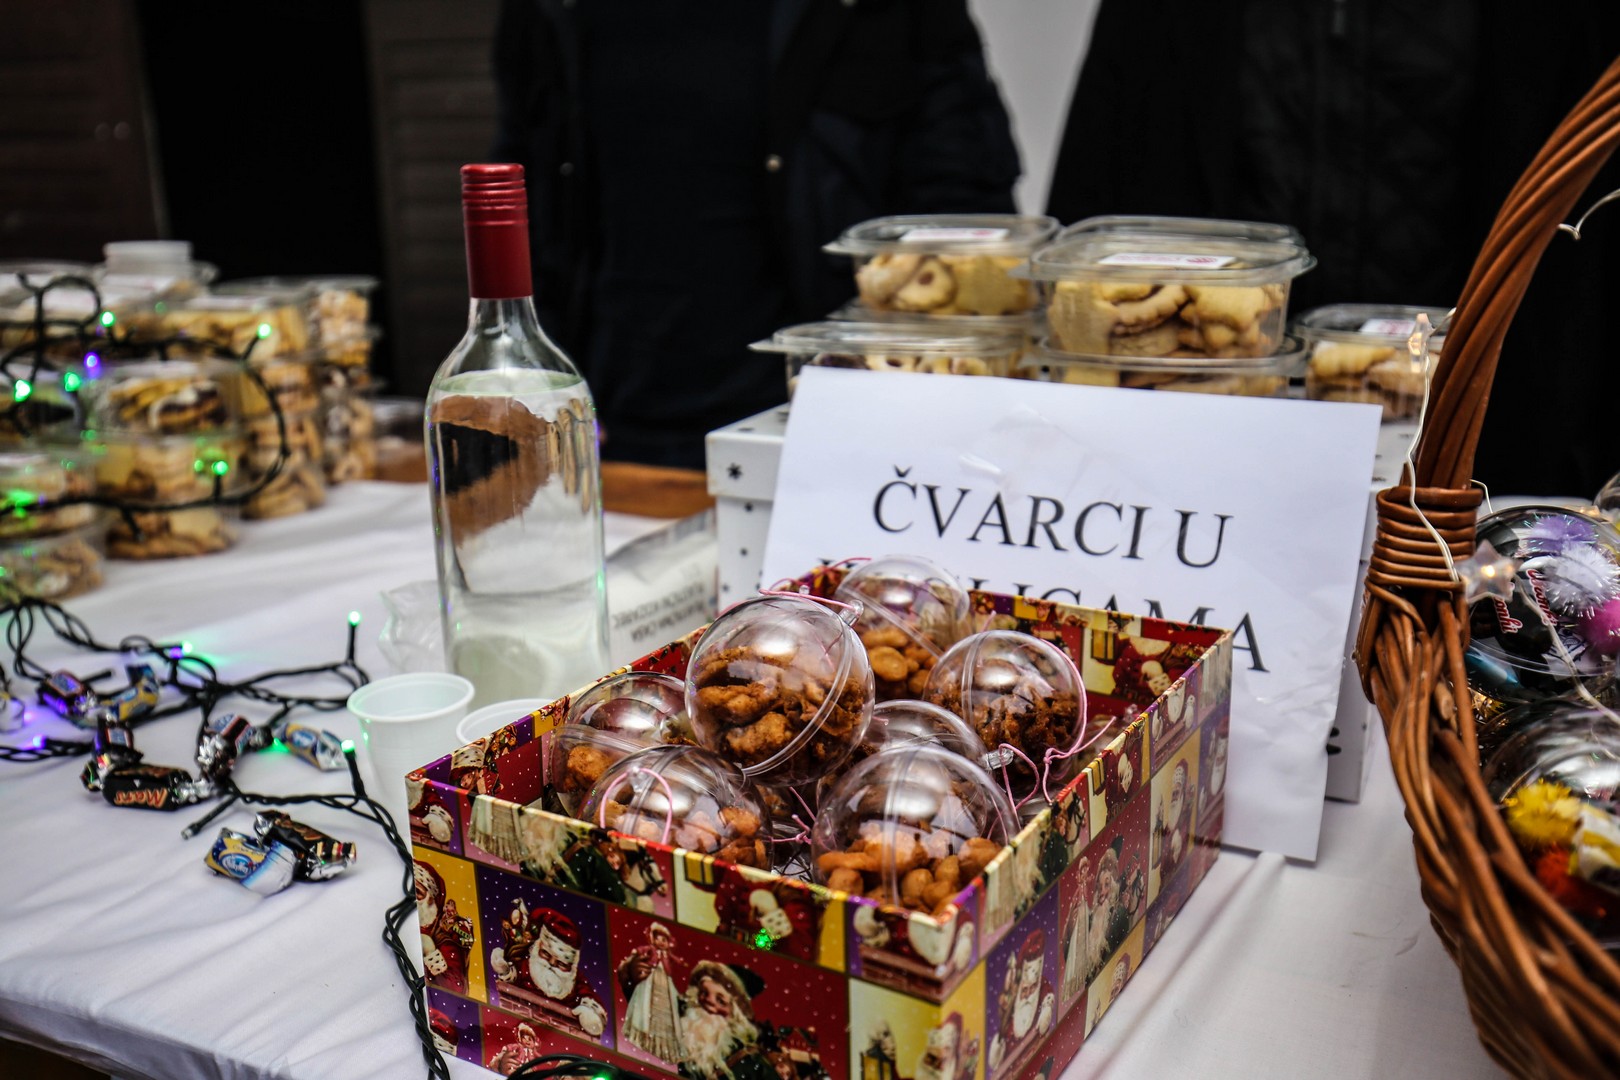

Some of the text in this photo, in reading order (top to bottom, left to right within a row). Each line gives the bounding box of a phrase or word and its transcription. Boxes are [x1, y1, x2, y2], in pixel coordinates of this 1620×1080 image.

[873, 465, 1234, 568] ČVARCI U
[114, 787, 168, 808] Mars
